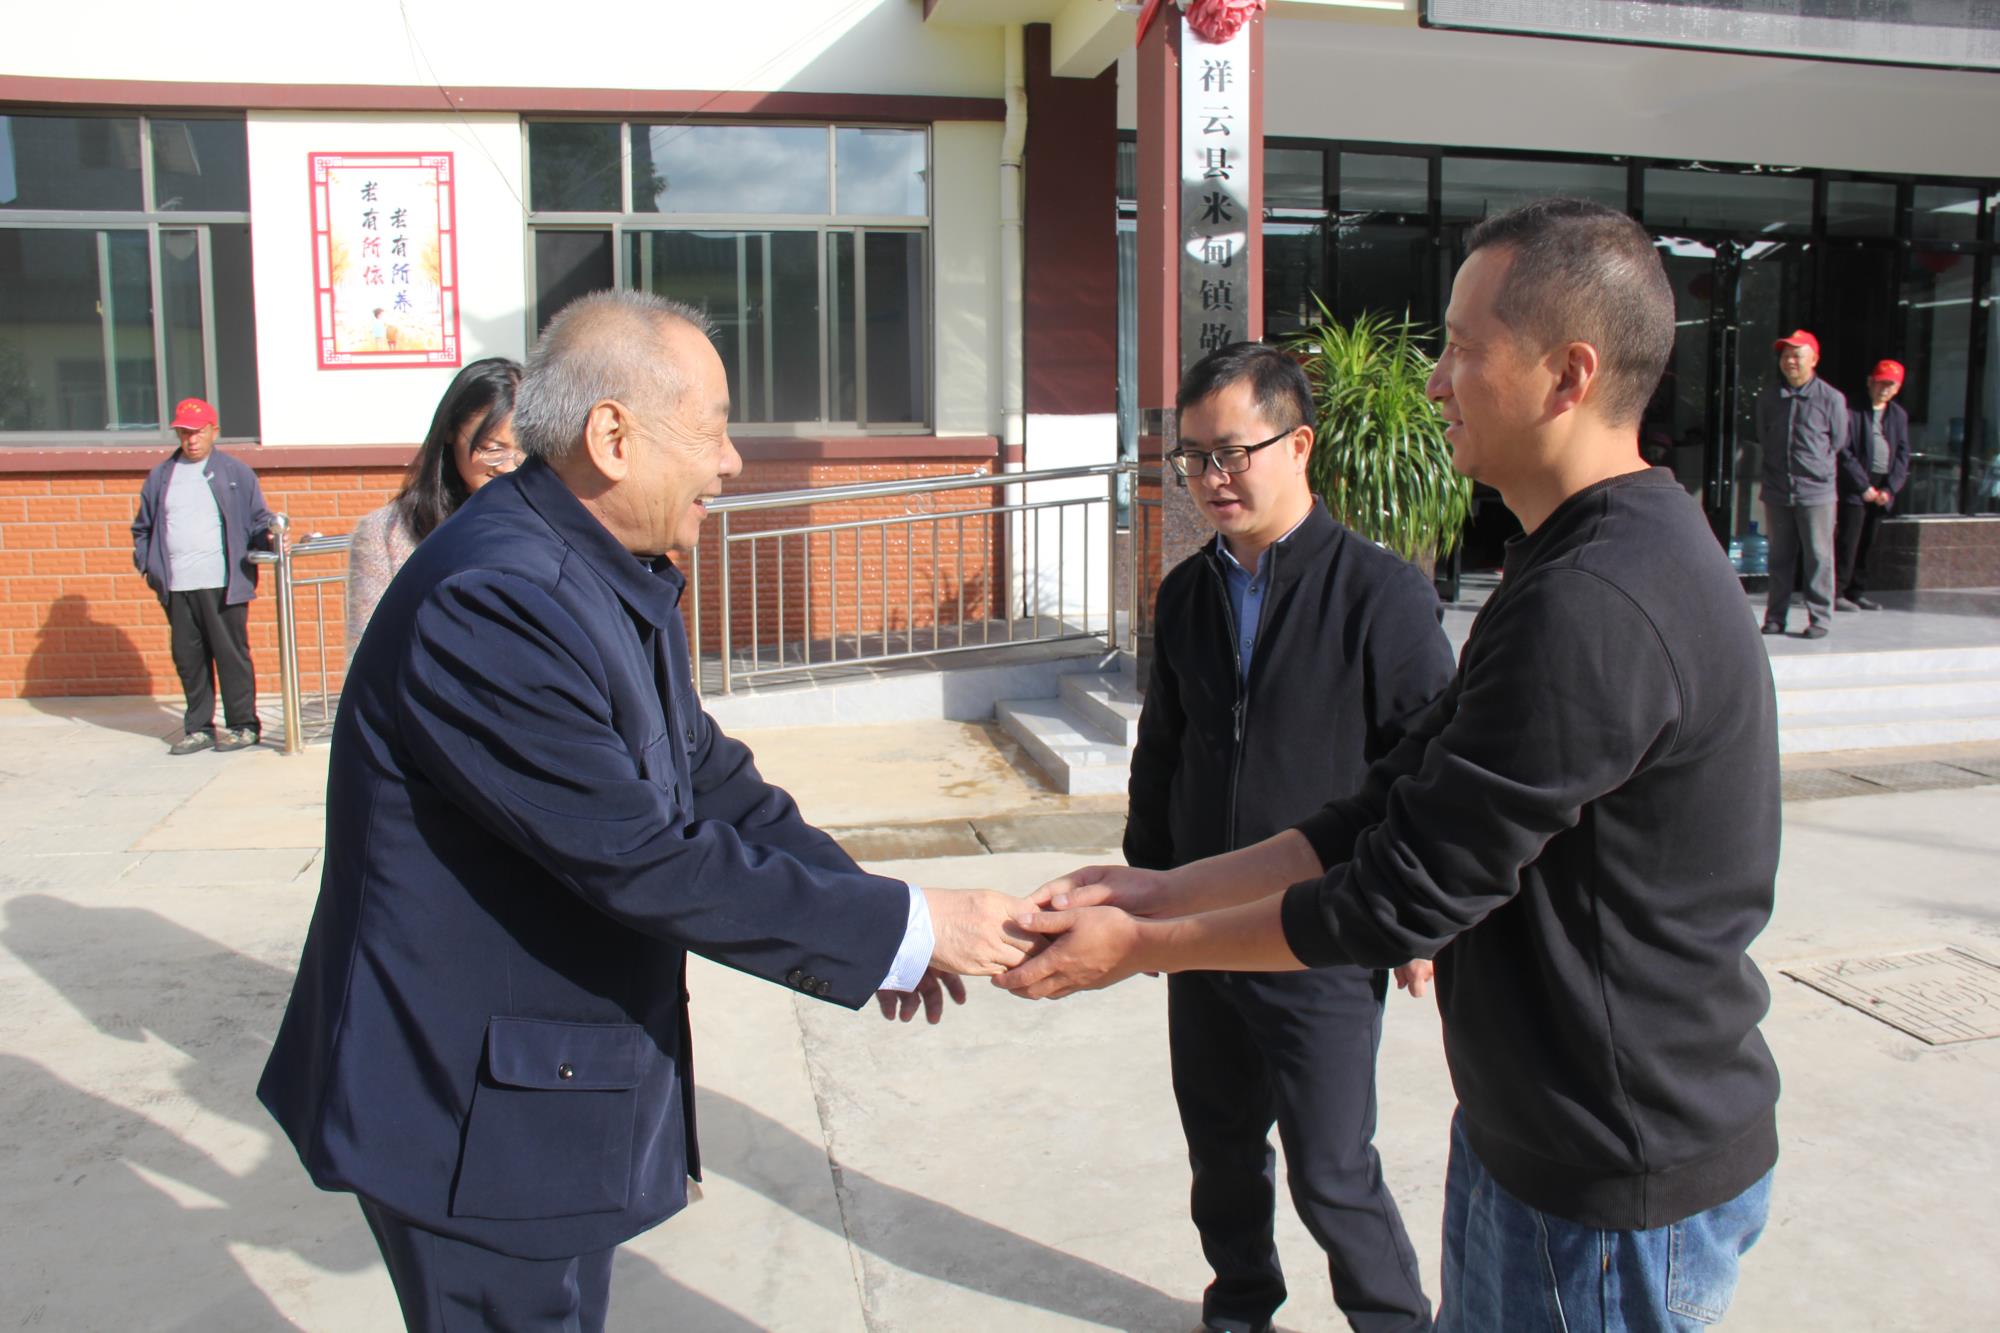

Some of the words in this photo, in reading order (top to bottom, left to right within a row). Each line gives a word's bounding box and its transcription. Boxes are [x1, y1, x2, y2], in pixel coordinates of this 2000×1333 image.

[361, 181, 384, 286] 老有所依
[390, 208, 412, 313] 老有所养
